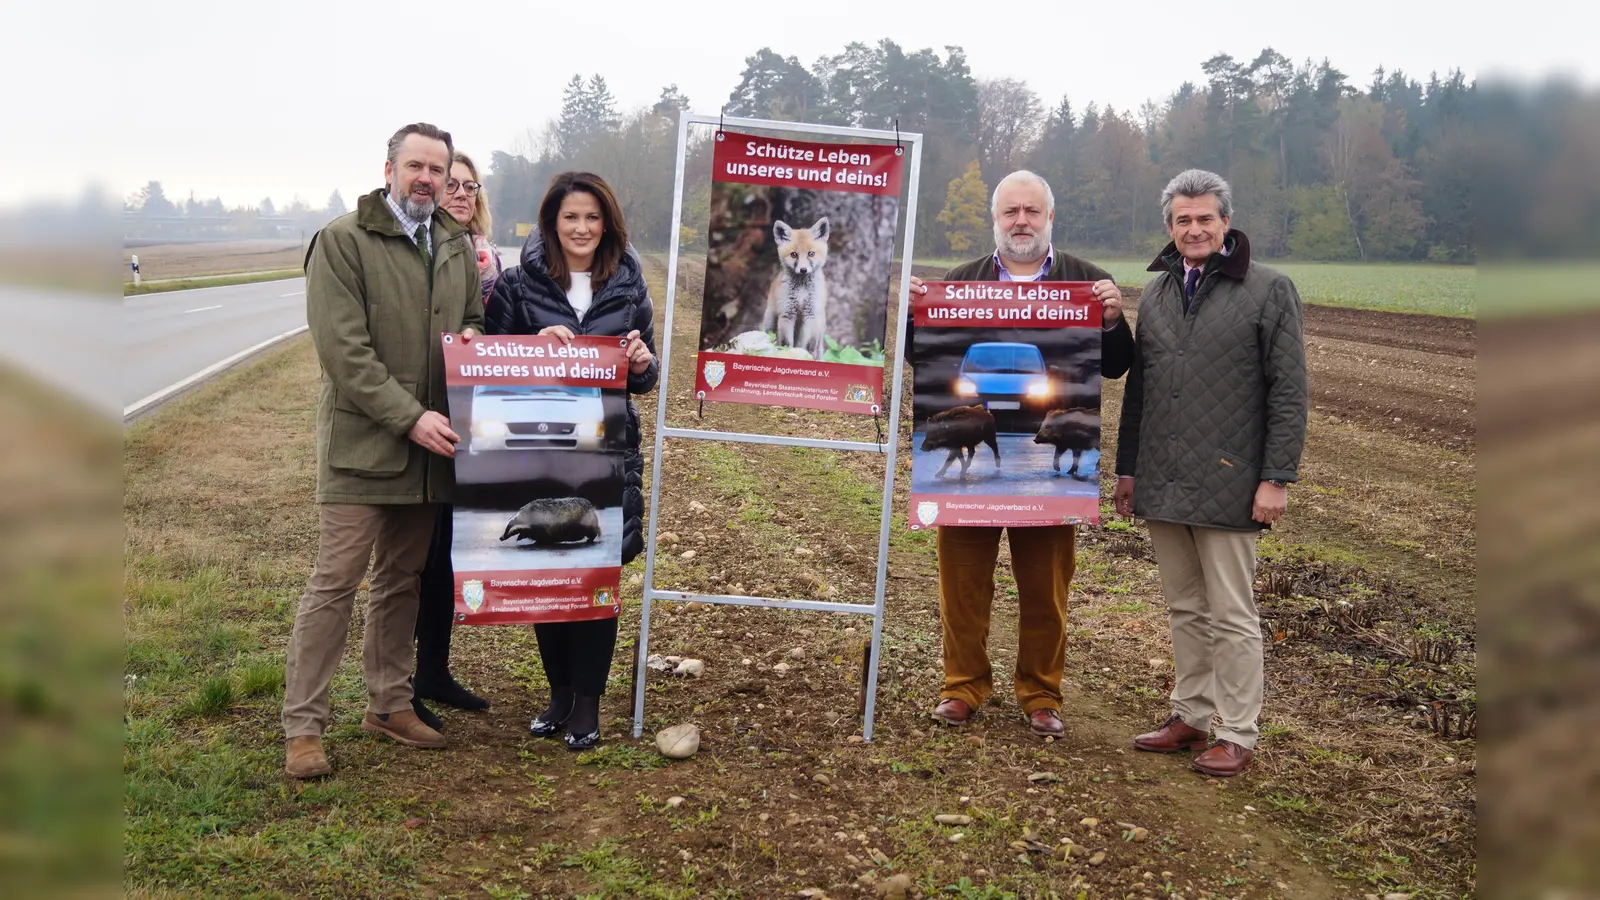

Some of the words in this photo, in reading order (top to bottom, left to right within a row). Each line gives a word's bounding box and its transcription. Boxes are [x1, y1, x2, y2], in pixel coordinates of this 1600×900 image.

[745, 141, 814, 161] Schütze
[818, 148, 871, 165] Leben
[726, 162, 793, 179] unseres
[797, 167, 831, 182] und
[835, 168, 888, 187] deins!
[945, 284, 1013, 300] Schütze
[1018, 285, 1070, 301] Leben
[927, 306, 993, 320] unseres
[998, 305, 1032, 320] und
[1036, 305, 1089, 321] deins!
[475, 342, 545, 358] Schütze
[548, 343, 599, 359] Leben
[460, 364, 529, 378] unseres
[533, 363, 567, 378] und
[570, 363, 617, 380] deins!
[732, 362, 772, 372] Bayerischer
[773, 366, 817, 376] Jagdverband
[817, 370, 830, 378] e.V.
[744, 381, 777, 390] Bayerisches
[816, 393, 838, 401] Forsten
[946, 502, 985, 510] Bayerischer
[986, 503, 1031, 512] Jagdverband
[490, 579, 528, 588] Bayerischer
[529, 577, 570, 587] Jagdverband
